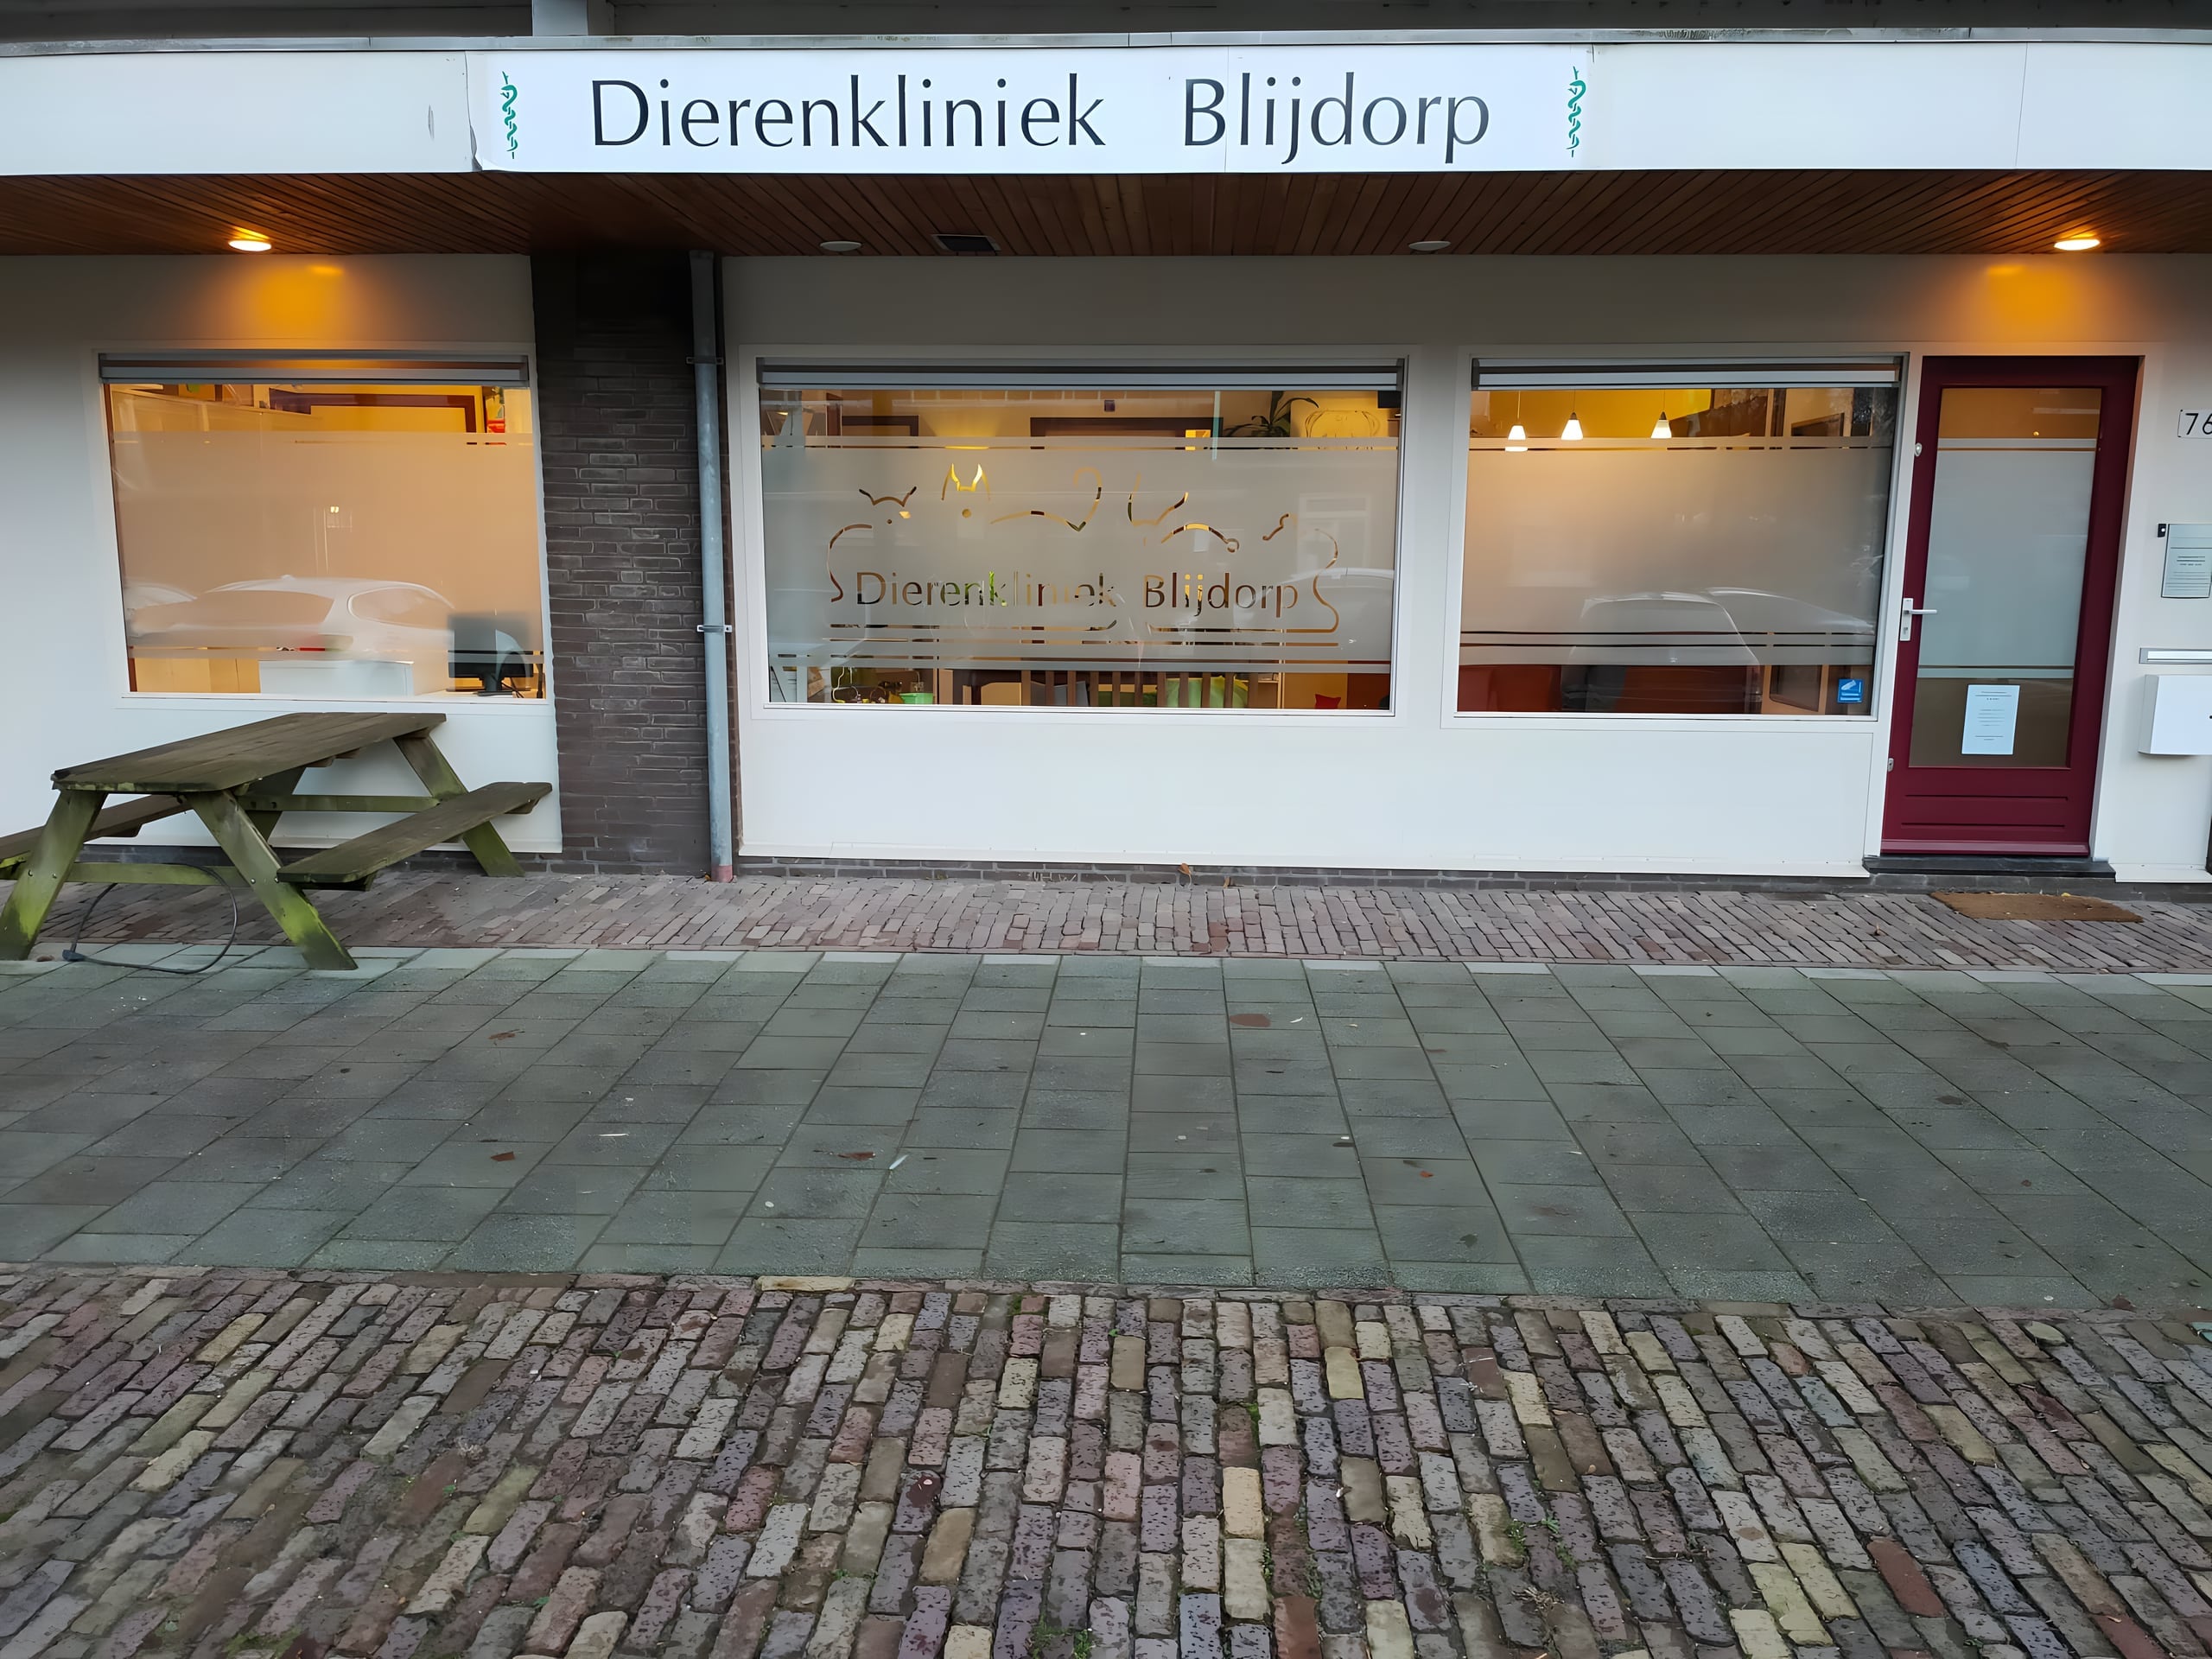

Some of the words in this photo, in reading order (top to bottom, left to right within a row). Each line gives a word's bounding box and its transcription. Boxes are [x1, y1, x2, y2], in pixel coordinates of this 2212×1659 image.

[592, 73, 1107, 148] Dierenkliniek
[1185, 72, 1490, 165] Blijdorp
[855, 570, 1118, 607] Dierenkliniek
[1143, 571, 1300, 618] Blijdorp
